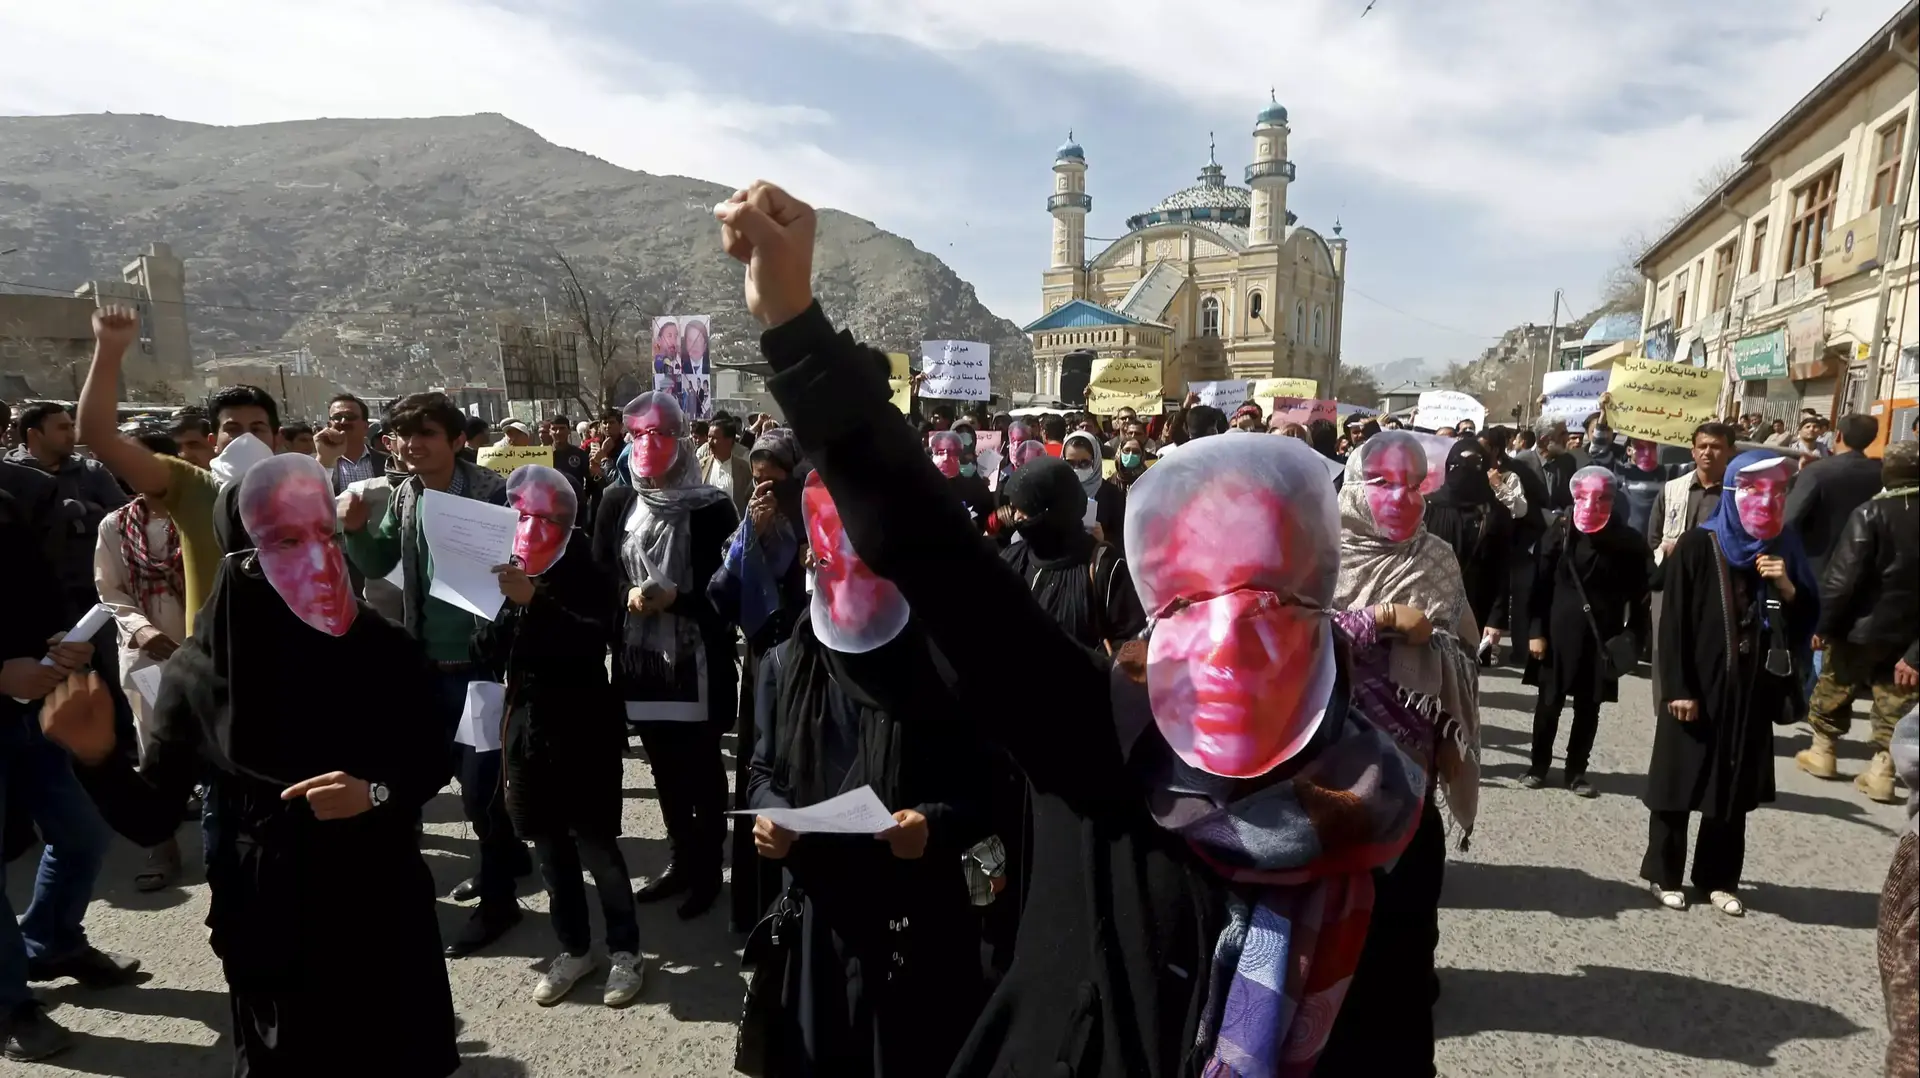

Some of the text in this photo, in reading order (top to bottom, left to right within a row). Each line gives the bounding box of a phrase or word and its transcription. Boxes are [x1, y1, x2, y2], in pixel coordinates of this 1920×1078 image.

[1650, 363, 1698, 379] جنایتکاران
[1700, 371, 1709, 379] تا
[1657, 387, 1683, 397] قدرت
[1682, 389, 1699, 400] خلع
[1636, 407, 1684, 421] فرخنده
[1684, 413, 1698, 423] روز
